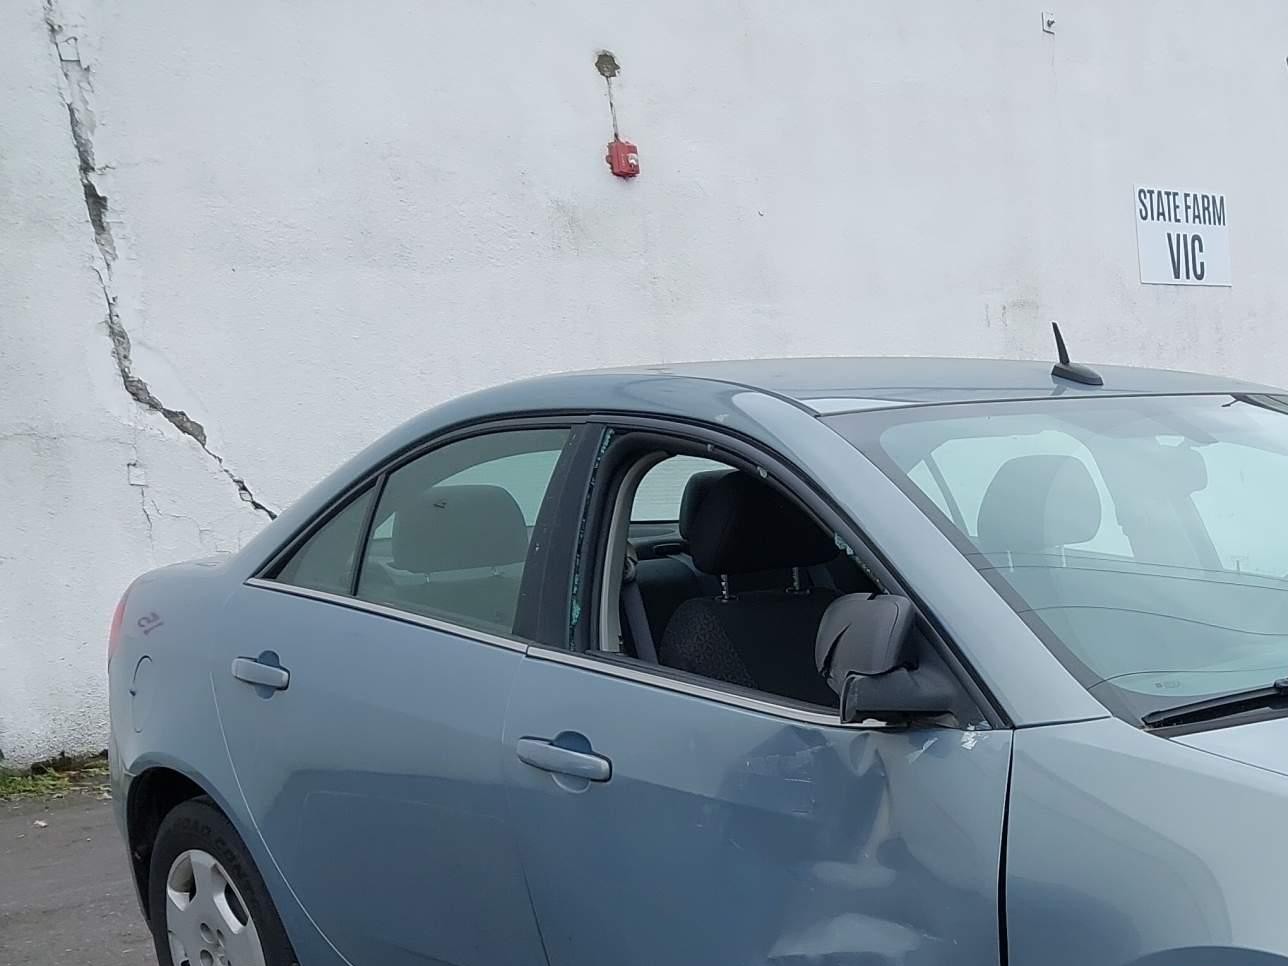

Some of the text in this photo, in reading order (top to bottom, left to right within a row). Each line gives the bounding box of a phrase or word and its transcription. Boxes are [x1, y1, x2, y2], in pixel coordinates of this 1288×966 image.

[1138, 188, 1226, 226] STATE FARM
[1166, 232, 1205, 281] VIC
